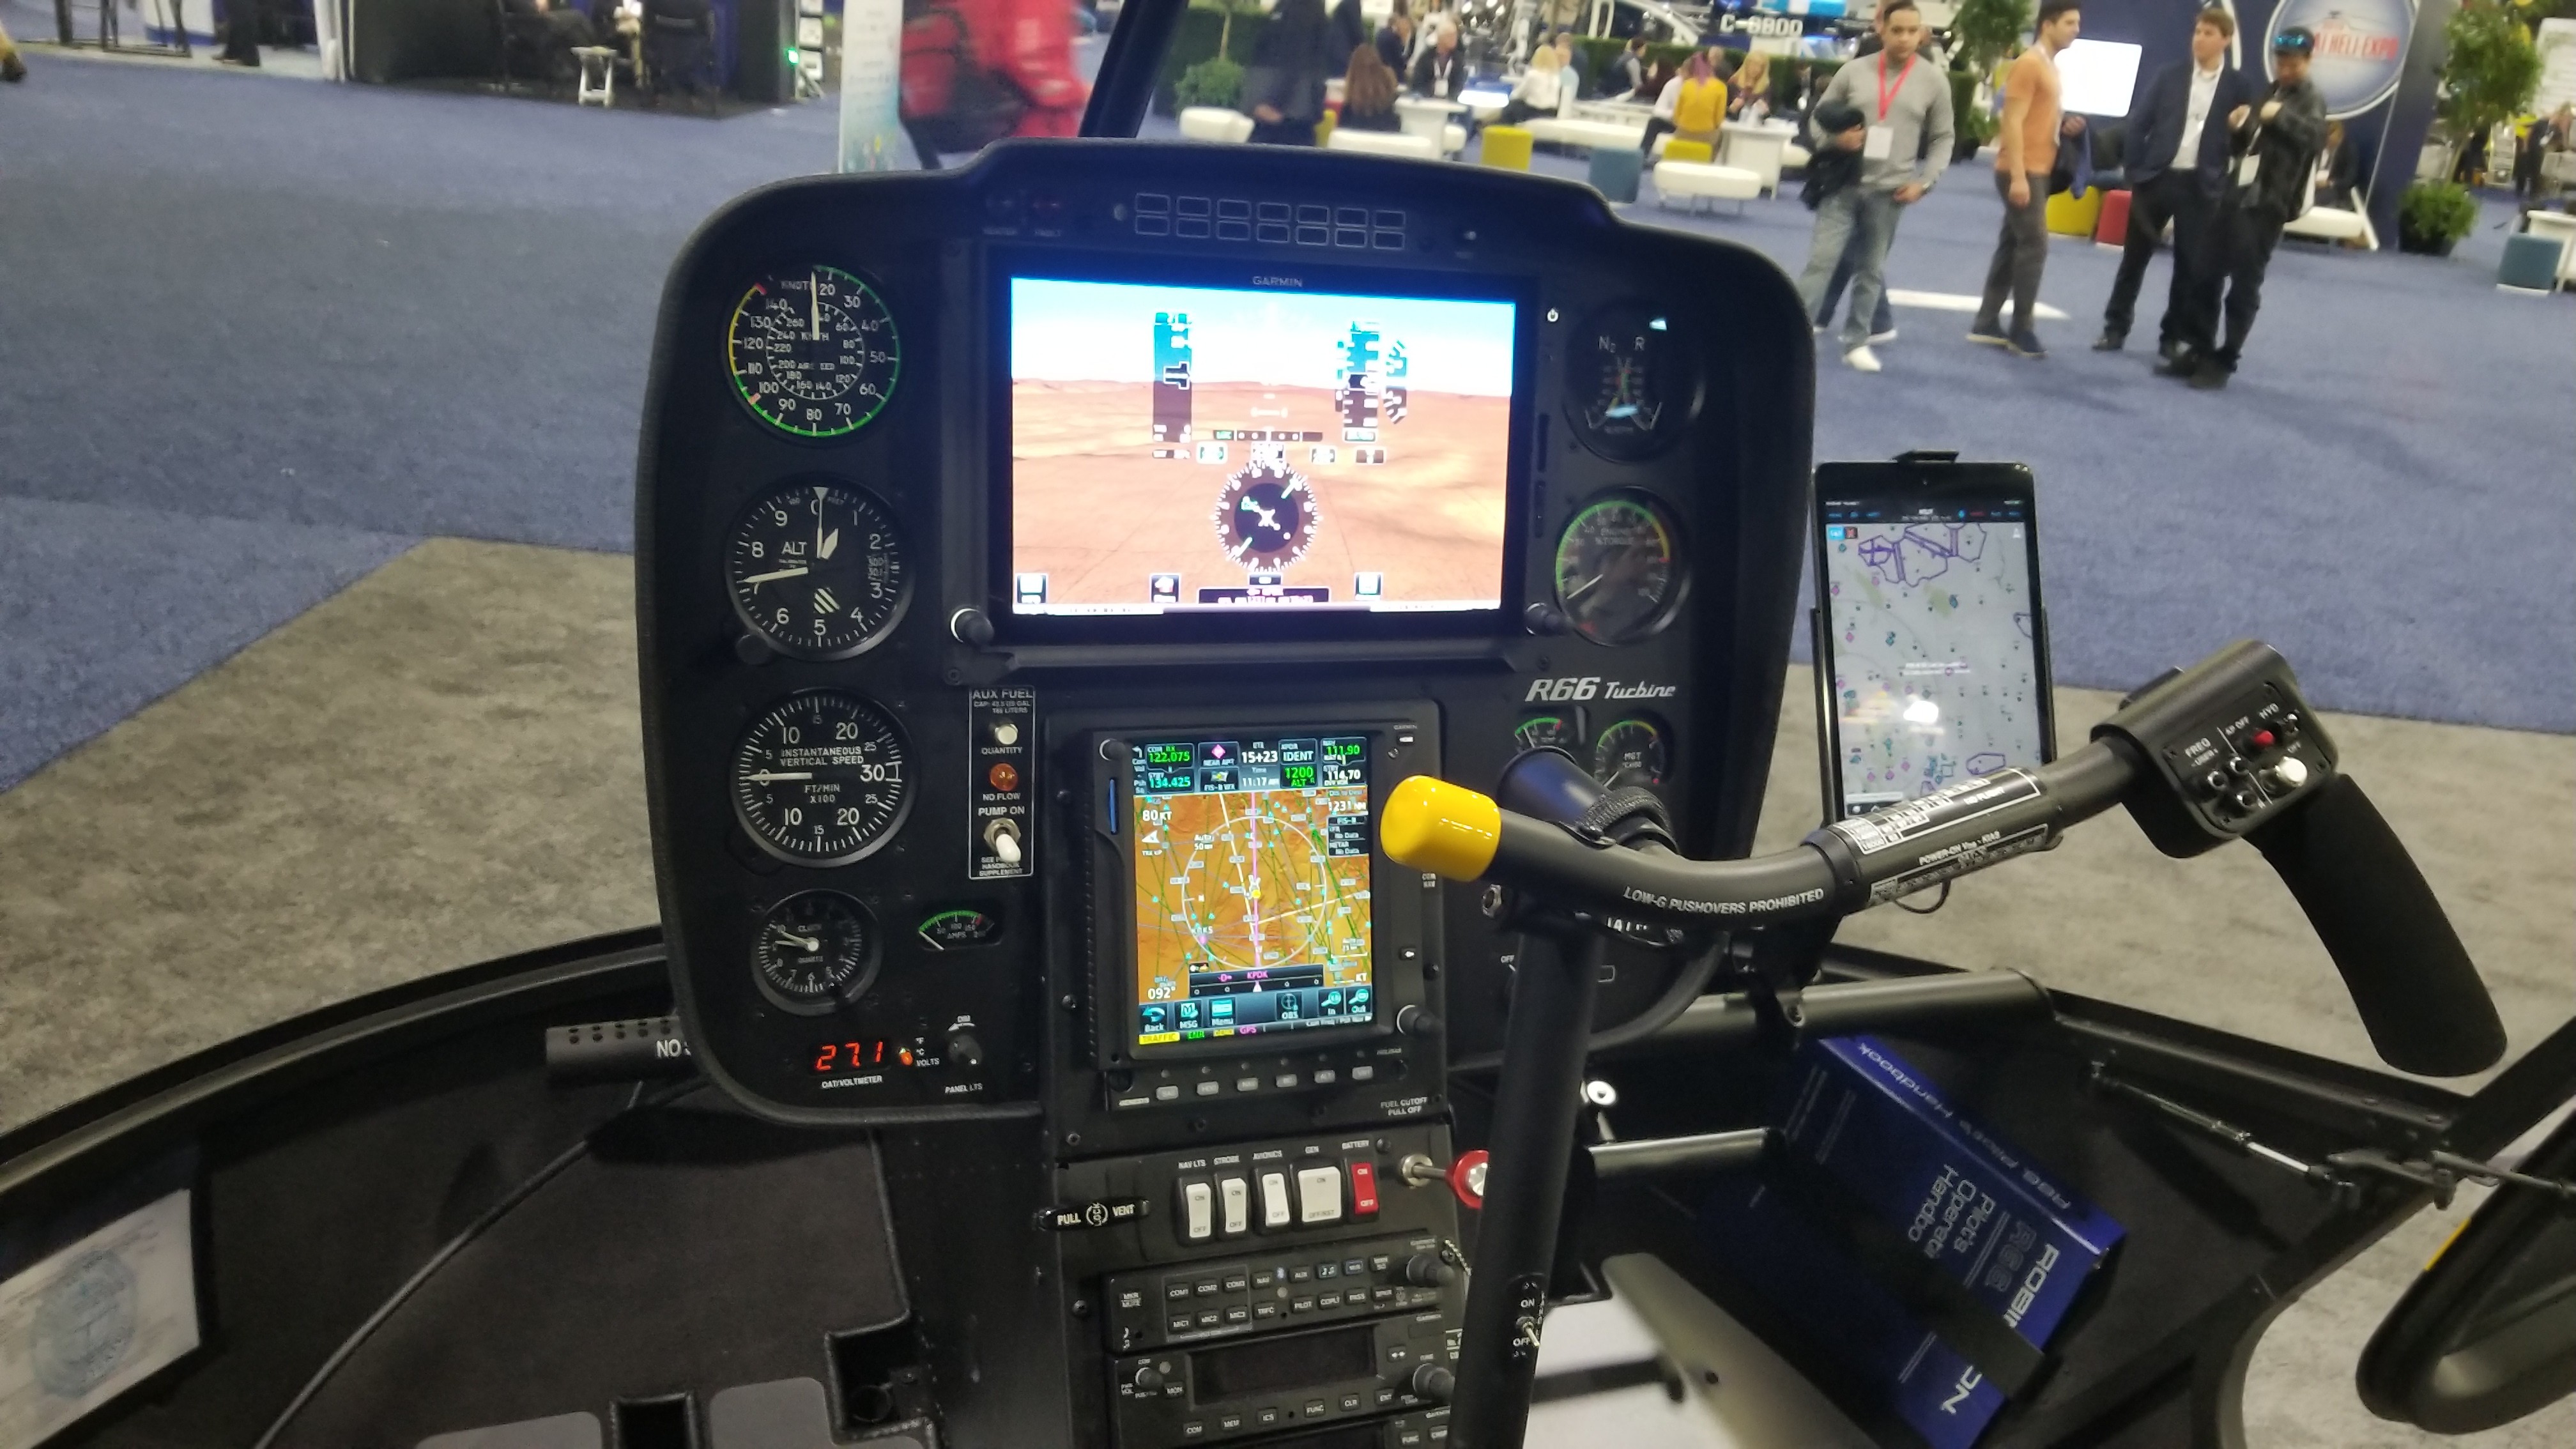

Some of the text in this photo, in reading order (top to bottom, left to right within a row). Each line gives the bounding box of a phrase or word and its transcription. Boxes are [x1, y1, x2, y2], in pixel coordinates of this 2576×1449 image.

[1253, 275, 1303, 286] GARMIN
[819, 283, 836, 296] 20
[843, 295, 861, 309] 30
[750, 316, 772, 329] 130
[862, 319, 880, 332] 40
[744, 337, 764, 349] 120
[870, 351, 886, 364] 50
[758, 381, 779, 394] 100
[859, 383, 877, 395] 60
[778, 397, 797, 411] 90
[834, 402, 852, 415] 70
[806, 408, 823, 421] 80
[774, 510, 788, 526] 9
[869, 533, 882, 549] 2
[751, 542, 765, 558] 8
[781, 541, 808, 555] ALT
[870, 582, 884, 599] 3
[776, 608, 790, 624] 6
[850, 607, 863, 623] 4
[813, 618, 827, 636] 5
[972, 688, 1034, 699] AUX FUEL
[1525, 677, 1676, 702] R66 Turbine
[783, 726, 800, 744] 10
[836, 721, 859, 740] 20
[781, 746, 861, 757] INSTANTANEOUS
[981, 746, 1023, 755] QUANTITY
[1283, 750, 1314, 762] IDENT
[1327, 744, 1360, 756] 111.90
[780, 755, 864, 767] VERTICAL SPEED
[1148, 751, 1190, 763] 122.075
[1241, 751, 1278, 763] 15+23
[860, 764, 885, 782] 30
[1285, 766, 1314, 779] 1200
[1328, 769, 1361, 780] 114.70
[804, 783, 841, 793] FT/MIN
[1149, 776, 1191, 789] 134.425
[1291, 779, 1307, 787] ALT
[785, 808, 803, 825] 10
[837, 807, 860, 826] 20
[978, 806, 1025, 816] PUMP ON
[813, 825, 825, 835] 15
[1623, 886, 1824, 914] LOW-G PUSHOVERS PROHIBITED
[1147, 986, 1176, 1000] 092°
[1179, 1020, 1198, 1029] MSG
[1239, 1026, 1257, 1035] GPS
[656, 1038, 682, 1057] NO
[916, 1057, 940, 1067] VOLTS
[1859, 1041, 1954, 1119] Handbook
[944, 1083, 983, 1094] PANEL LTS
[1381, 1096, 1429, 1108] FUEL CUTOFF
[1388, 1105, 1422, 1116] PULL OFF
[1057, 1213, 1082, 1226] PULL
[1112, 1204, 1135, 1216] VENT
[1521, 1298, 1535, 1308] ON
